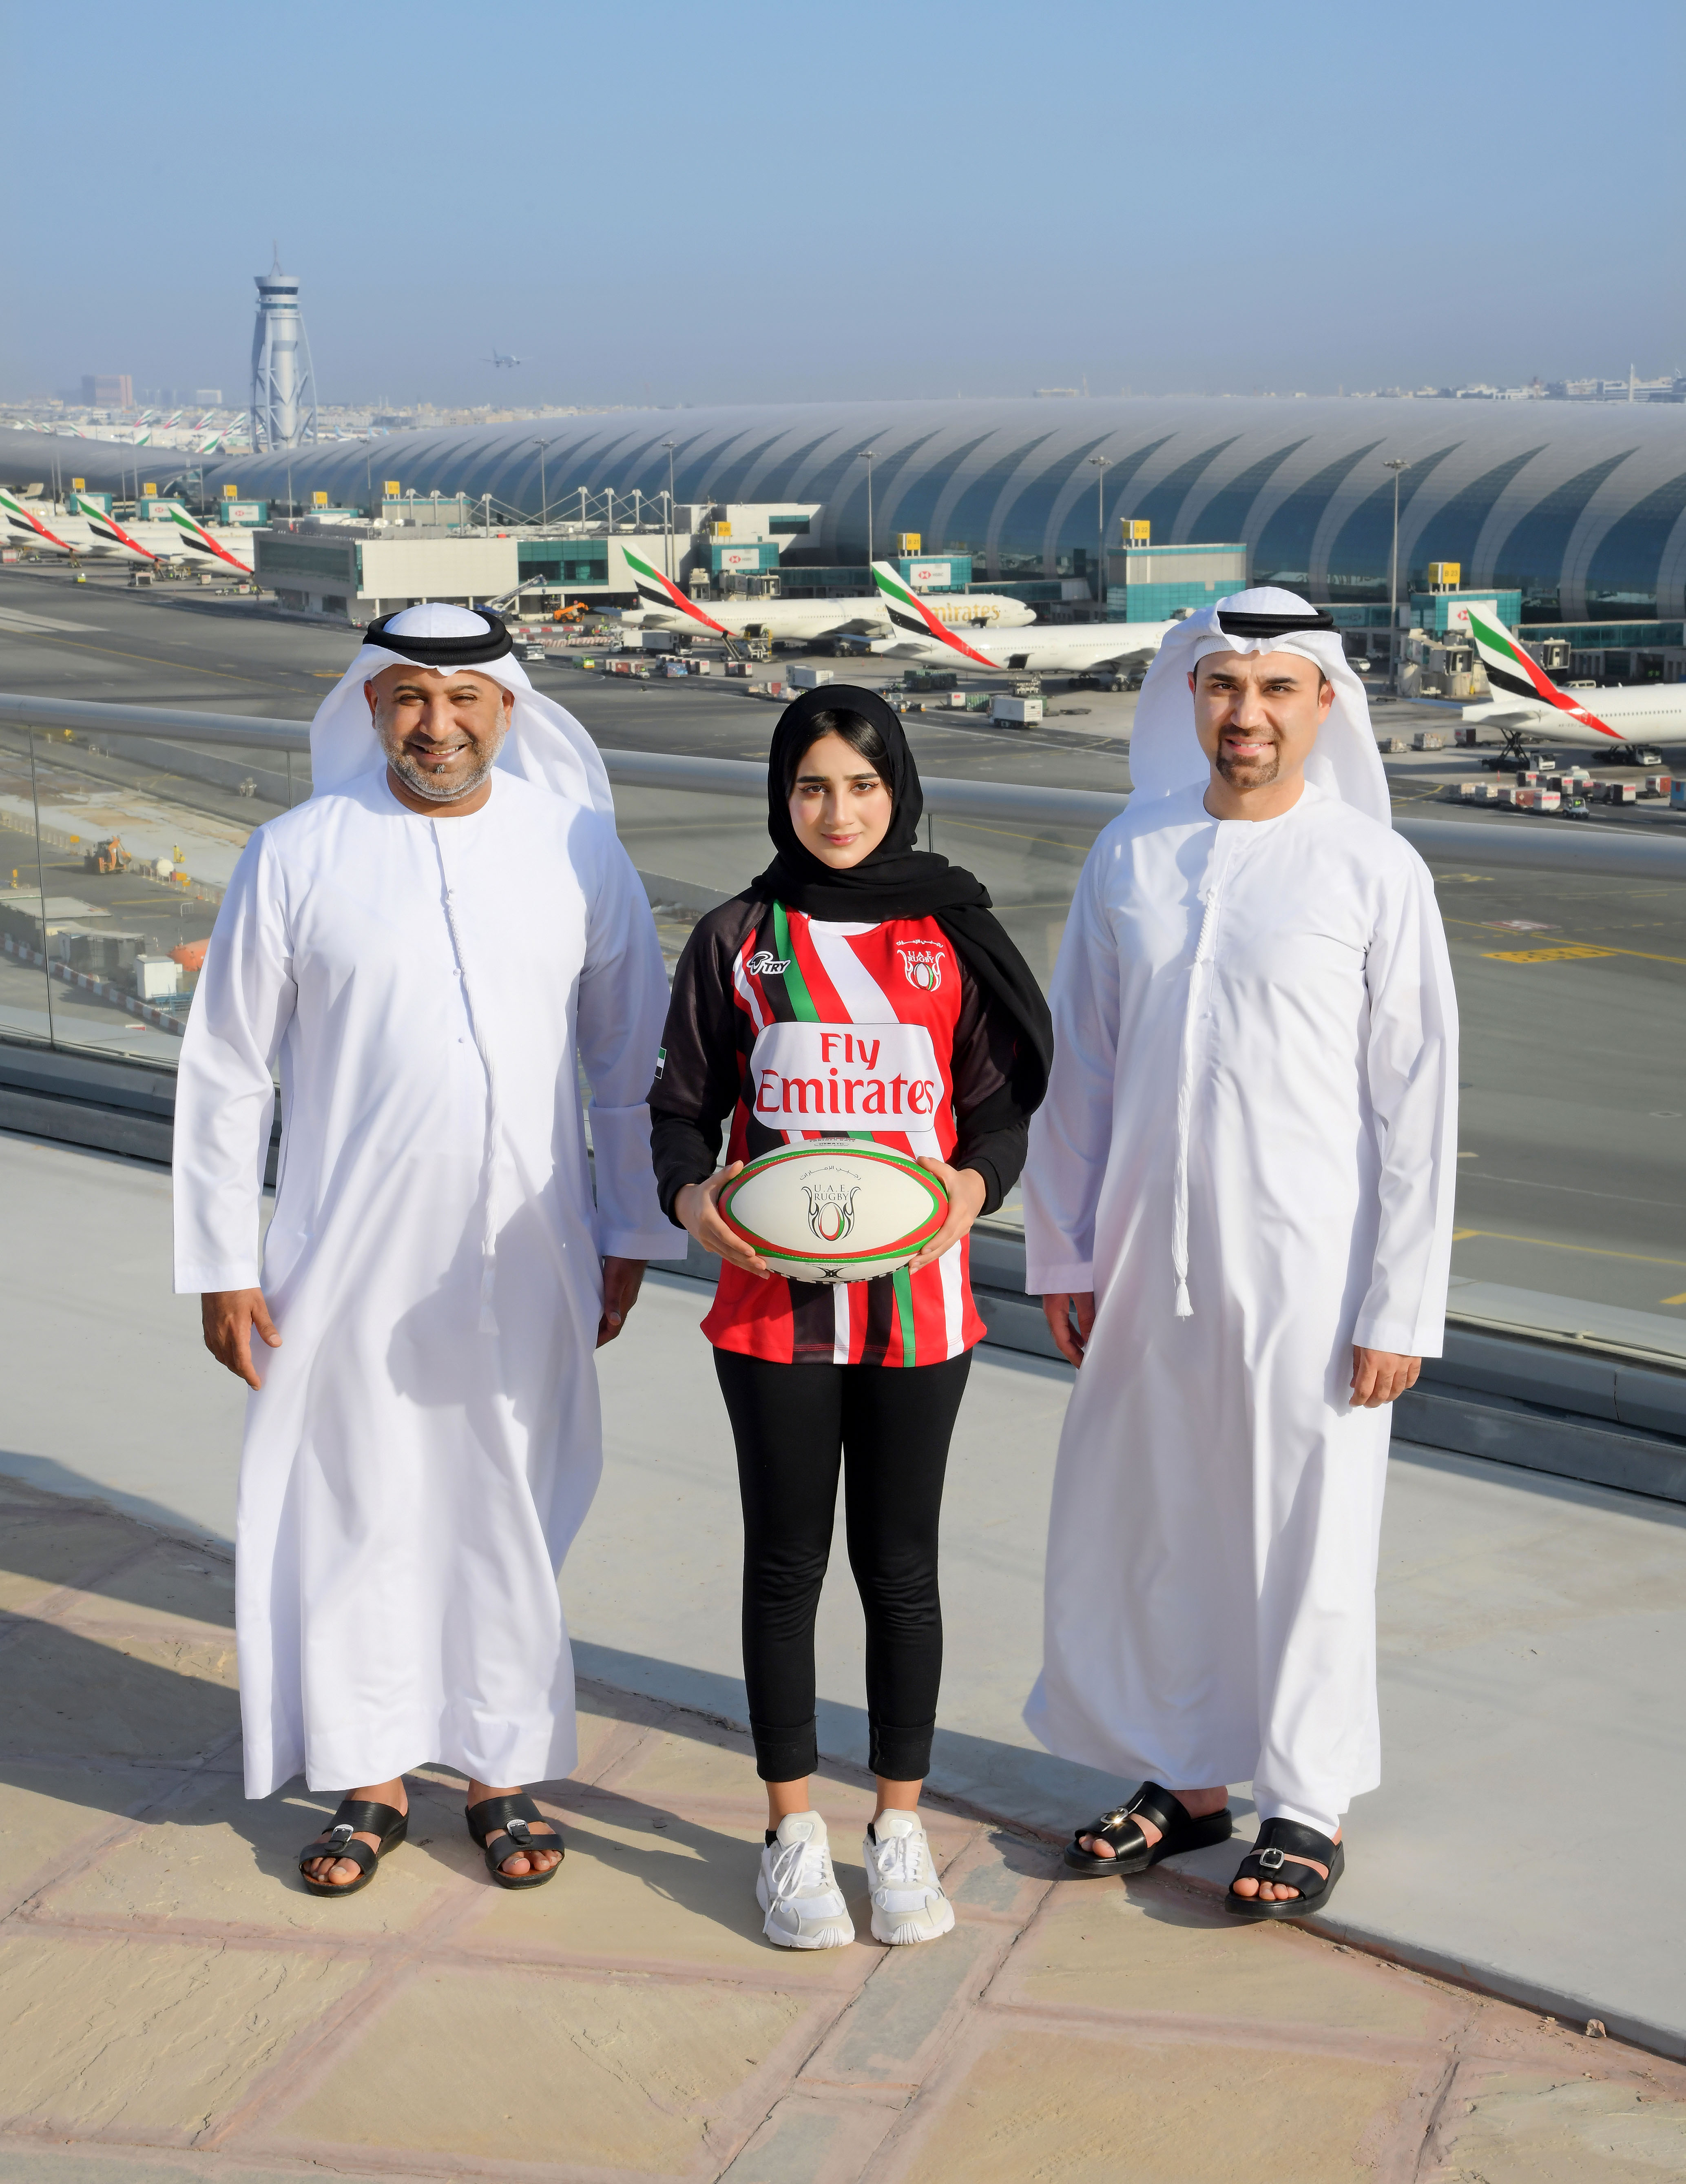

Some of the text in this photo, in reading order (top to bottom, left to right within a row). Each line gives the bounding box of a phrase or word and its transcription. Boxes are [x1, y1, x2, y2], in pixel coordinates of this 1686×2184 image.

[929, 602, 1000, 621] mirates
[764, 961, 789, 972] TRY
[820, 1033, 880, 1070] Fly
[756, 1067, 935, 1115] Emirates
